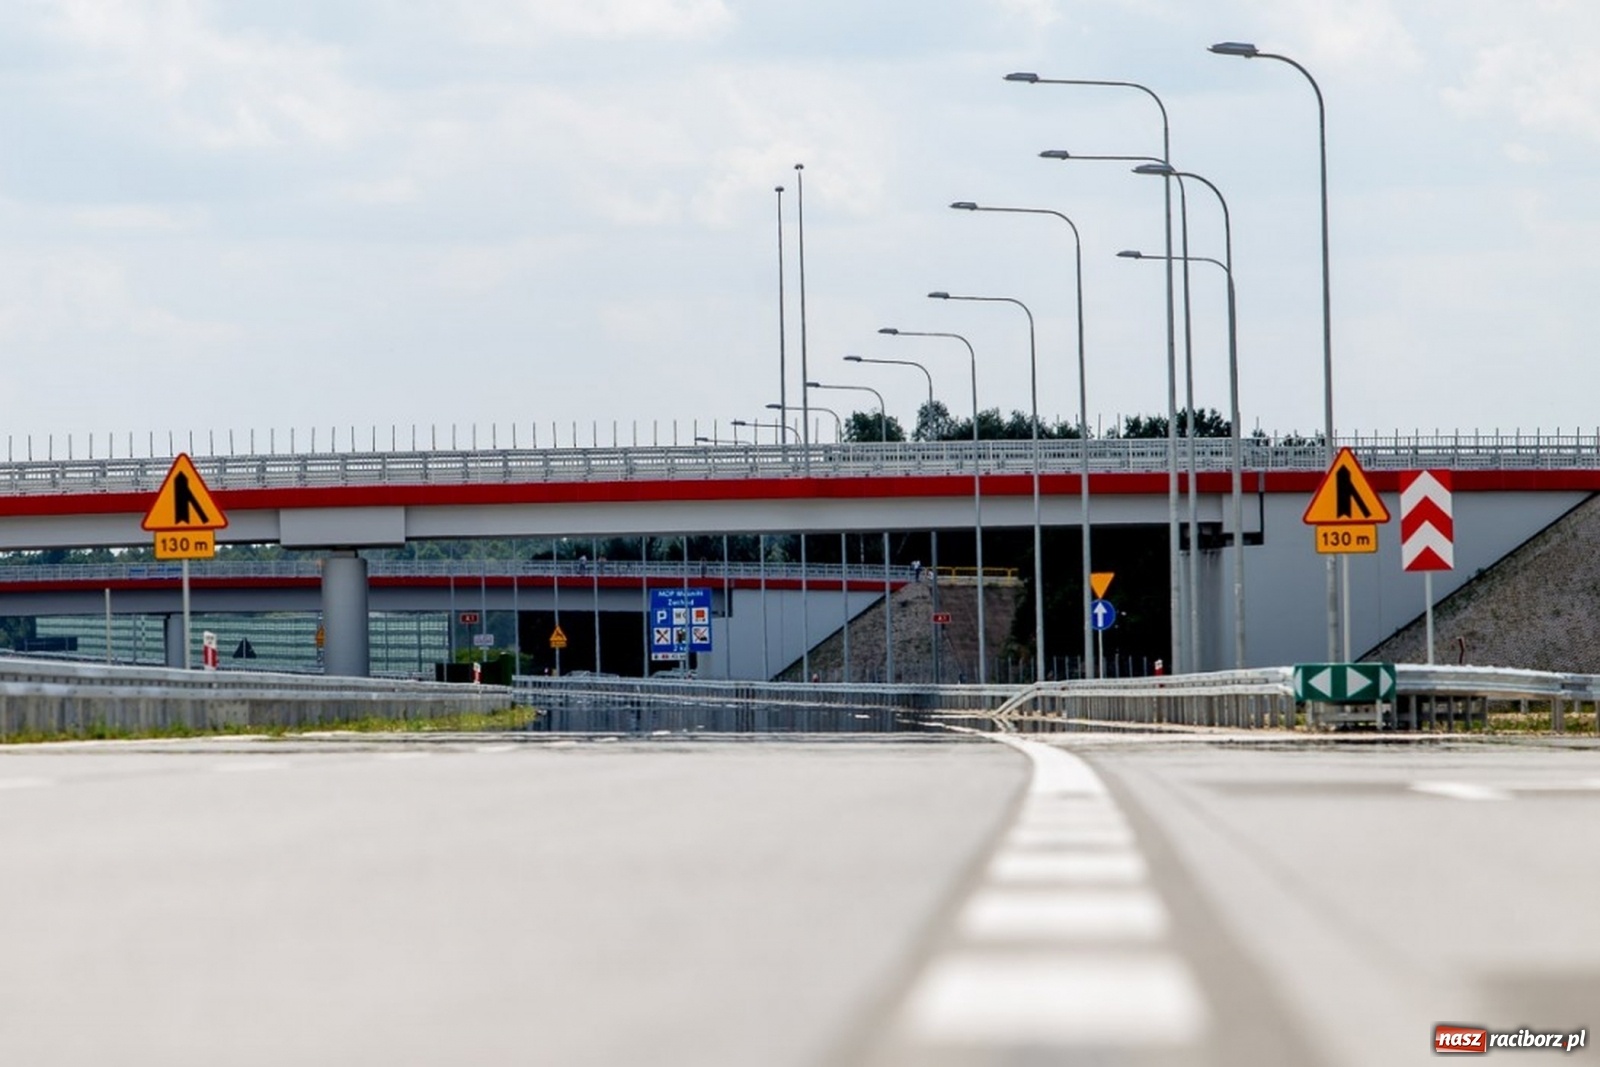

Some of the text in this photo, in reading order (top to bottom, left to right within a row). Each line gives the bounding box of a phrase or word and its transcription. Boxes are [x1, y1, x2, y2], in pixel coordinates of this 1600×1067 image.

[161, 537, 208, 552] 130 m
[1322, 531, 1370, 546] 130 m
[657, 610, 667, 624] P
